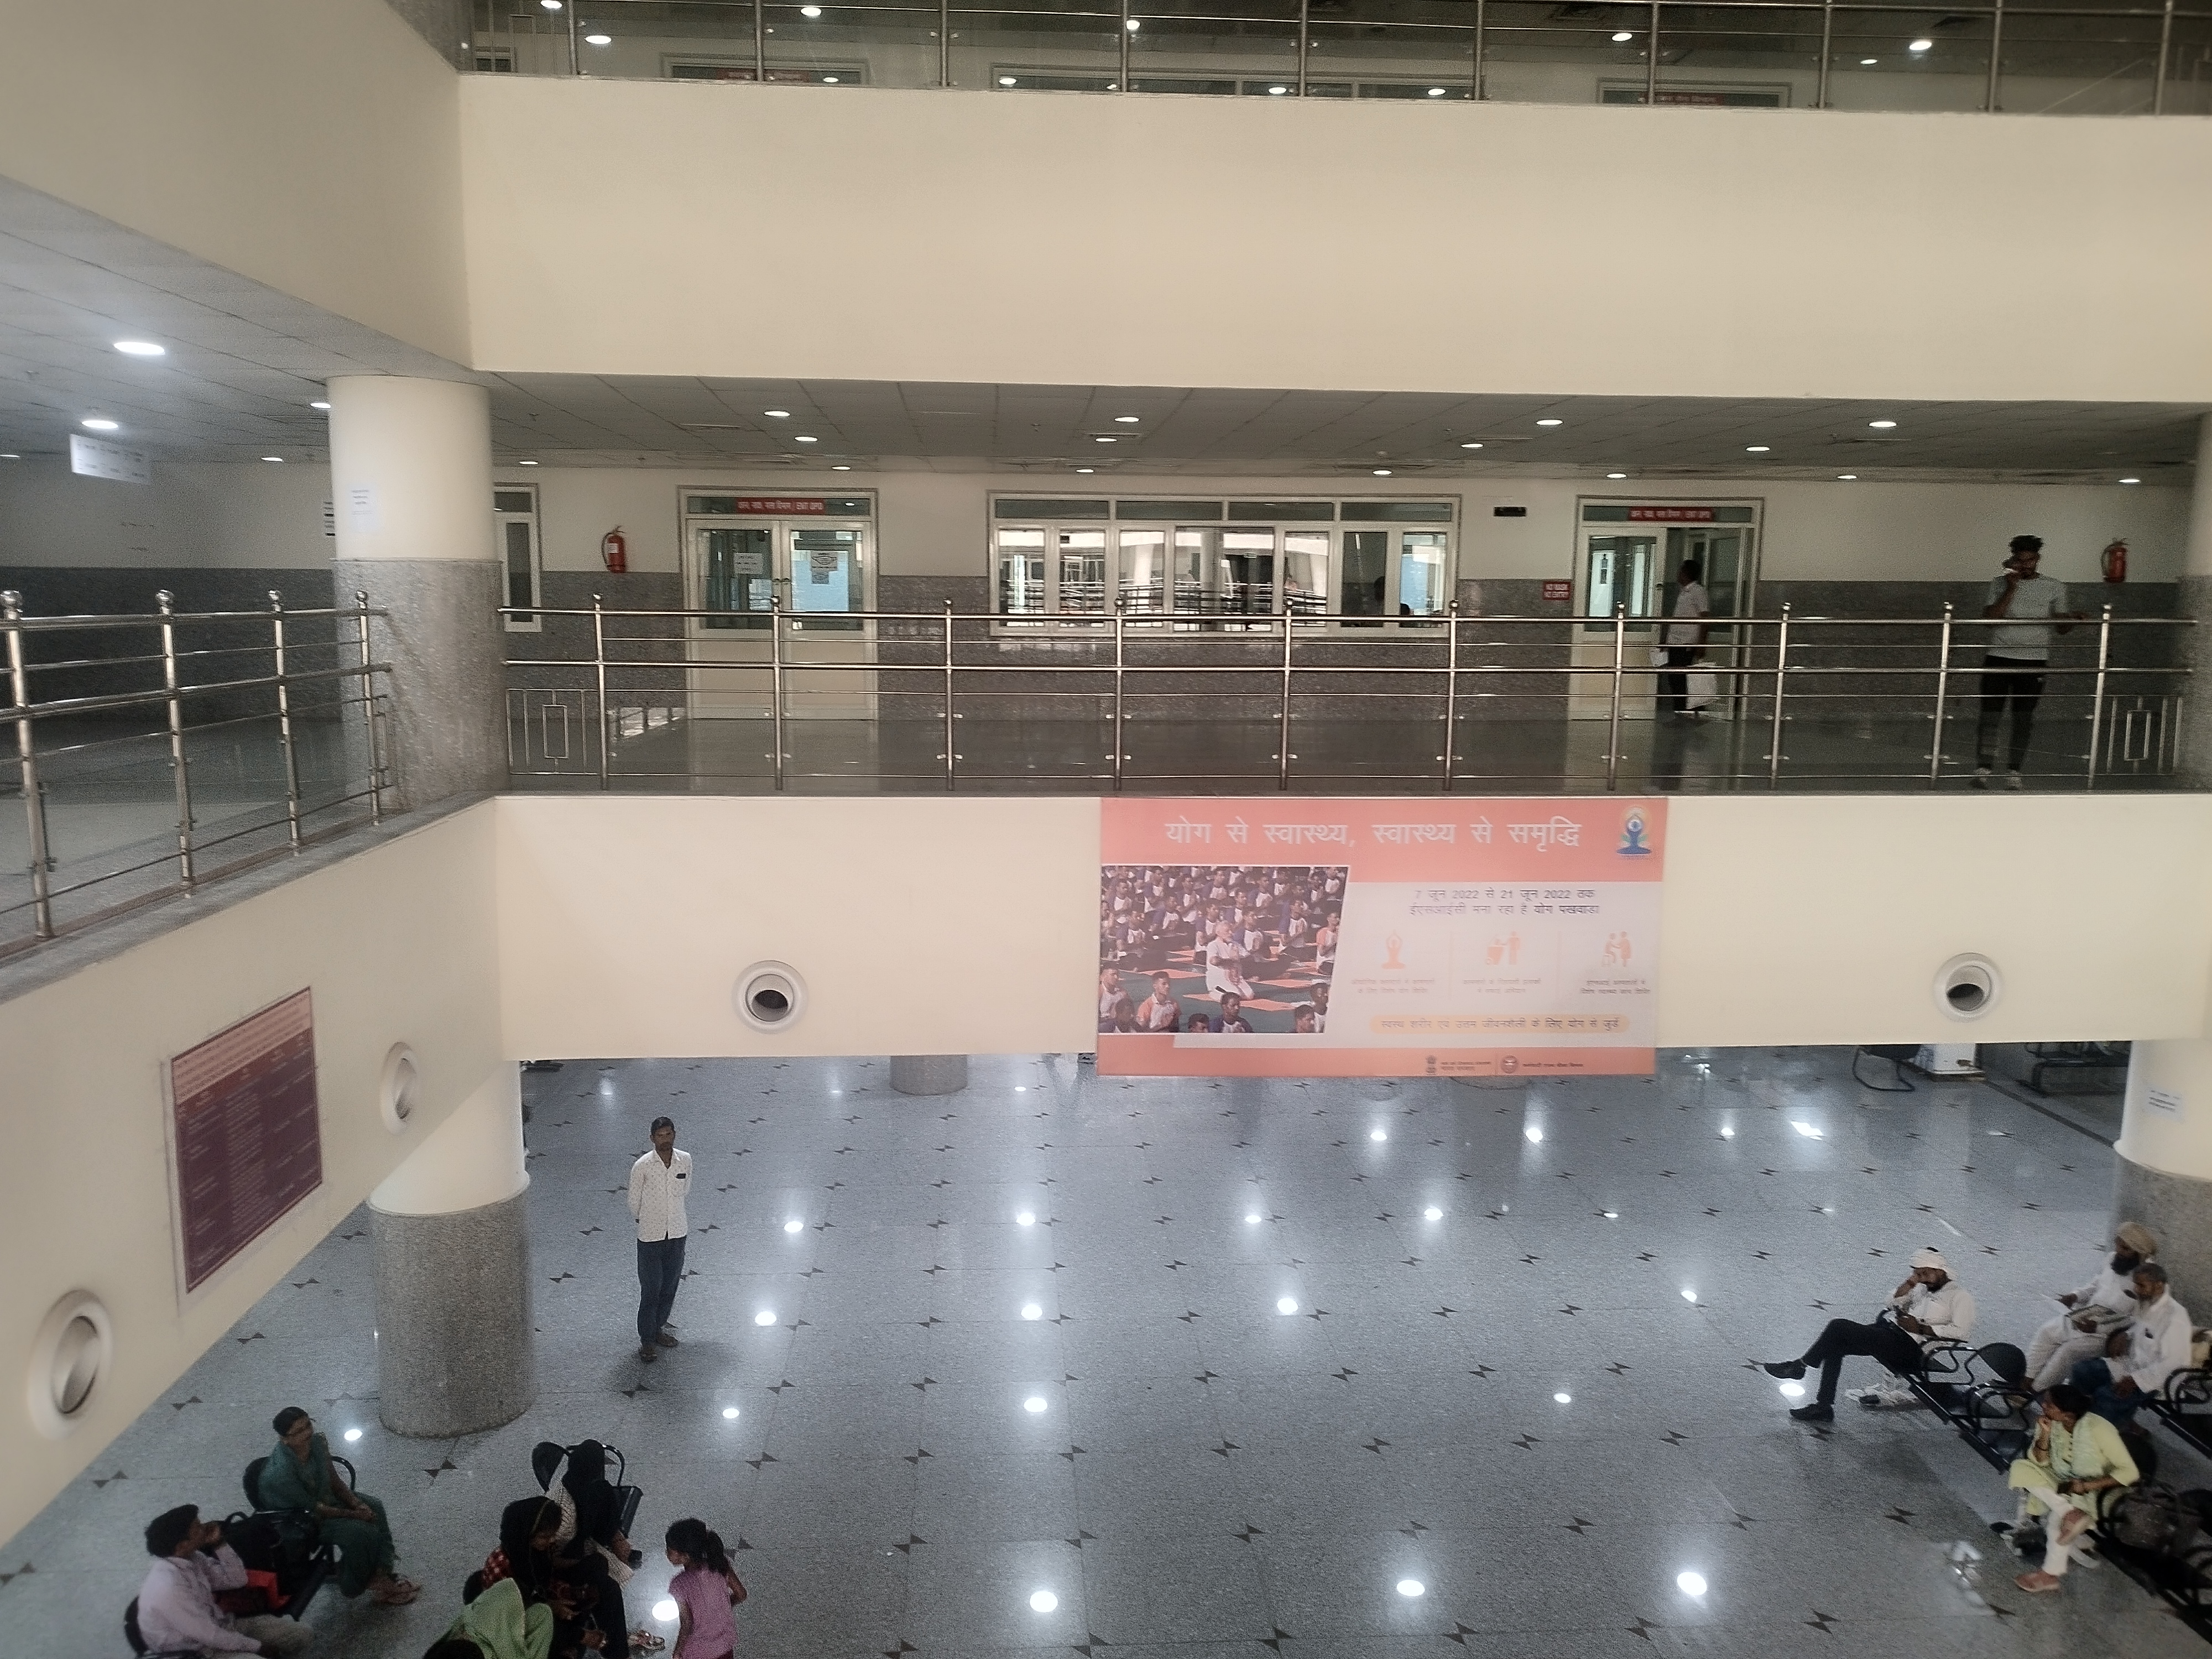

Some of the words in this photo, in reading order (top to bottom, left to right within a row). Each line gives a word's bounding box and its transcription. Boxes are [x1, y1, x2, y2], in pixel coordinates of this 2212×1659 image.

[1165, 816, 1212, 843] योग
[1225, 816, 1249, 844] से
[1262, 824, 1356, 848] स्वास्थ्य,
[1371, 823, 1457, 844] स्वास्थ्य
[1469, 816, 1494, 844] से
[1506, 815, 1582, 852] समृद्धि
[1414, 890, 1422, 899] 7
[1427, 890, 1446, 902] जून
[1452, 890, 1479, 899] 2022
[1484, 886, 1494, 899] से
[1500, 889, 1513, 899] 21
[1520, 889, 1538, 902] जून
[1543, 889, 1571, 899] 2022
[1576, 889, 1595, 899] तक
[1533, 902, 1553, 914] योग
[1545, 1017, 1563, 1029] लिए
